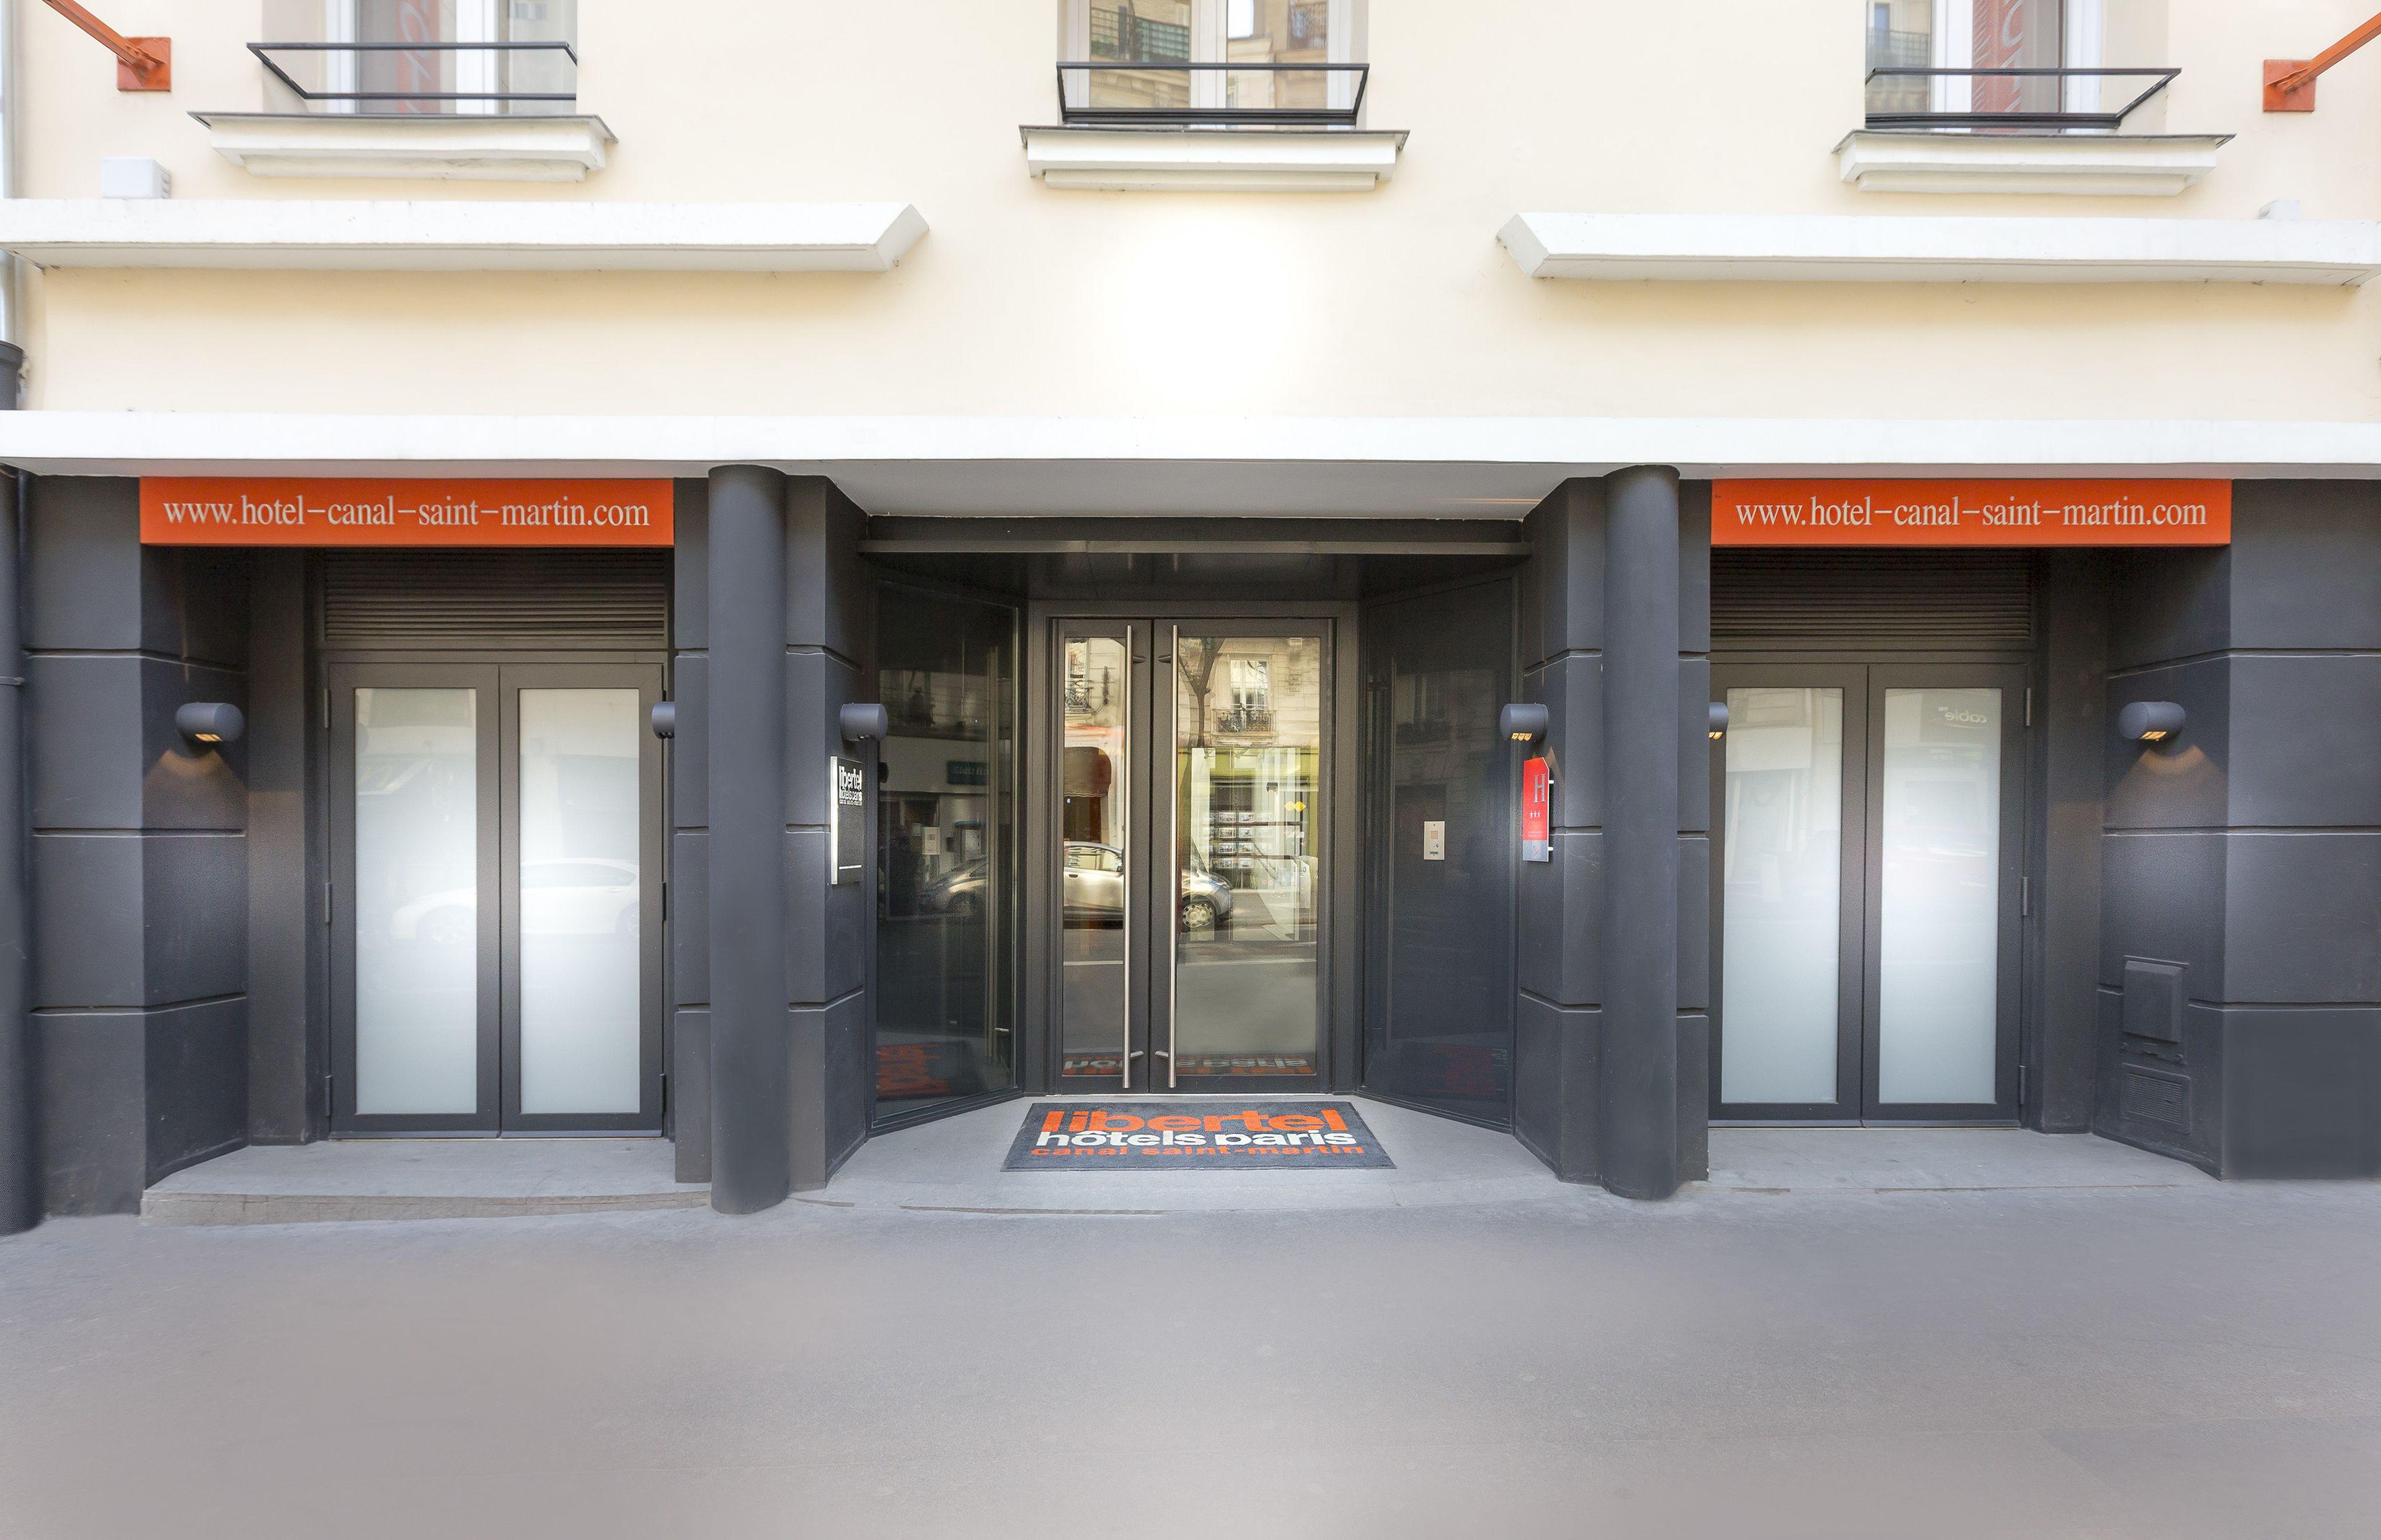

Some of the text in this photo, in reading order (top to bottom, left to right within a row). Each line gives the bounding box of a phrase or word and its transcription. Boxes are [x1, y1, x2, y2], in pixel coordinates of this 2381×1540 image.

[162, 495, 650, 527] www.hotel-canal-saint-martin.com
[1736, 496, 2207, 526] www.hotel-canal-saint-martin.com
[1533, 773, 1546, 803] H
[1042, 1109, 1348, 1132] libertel
[1031, 1145, 1364, 1156] canal saint-martin
[1036, 1130, 1357, 1146] hôtels paris
